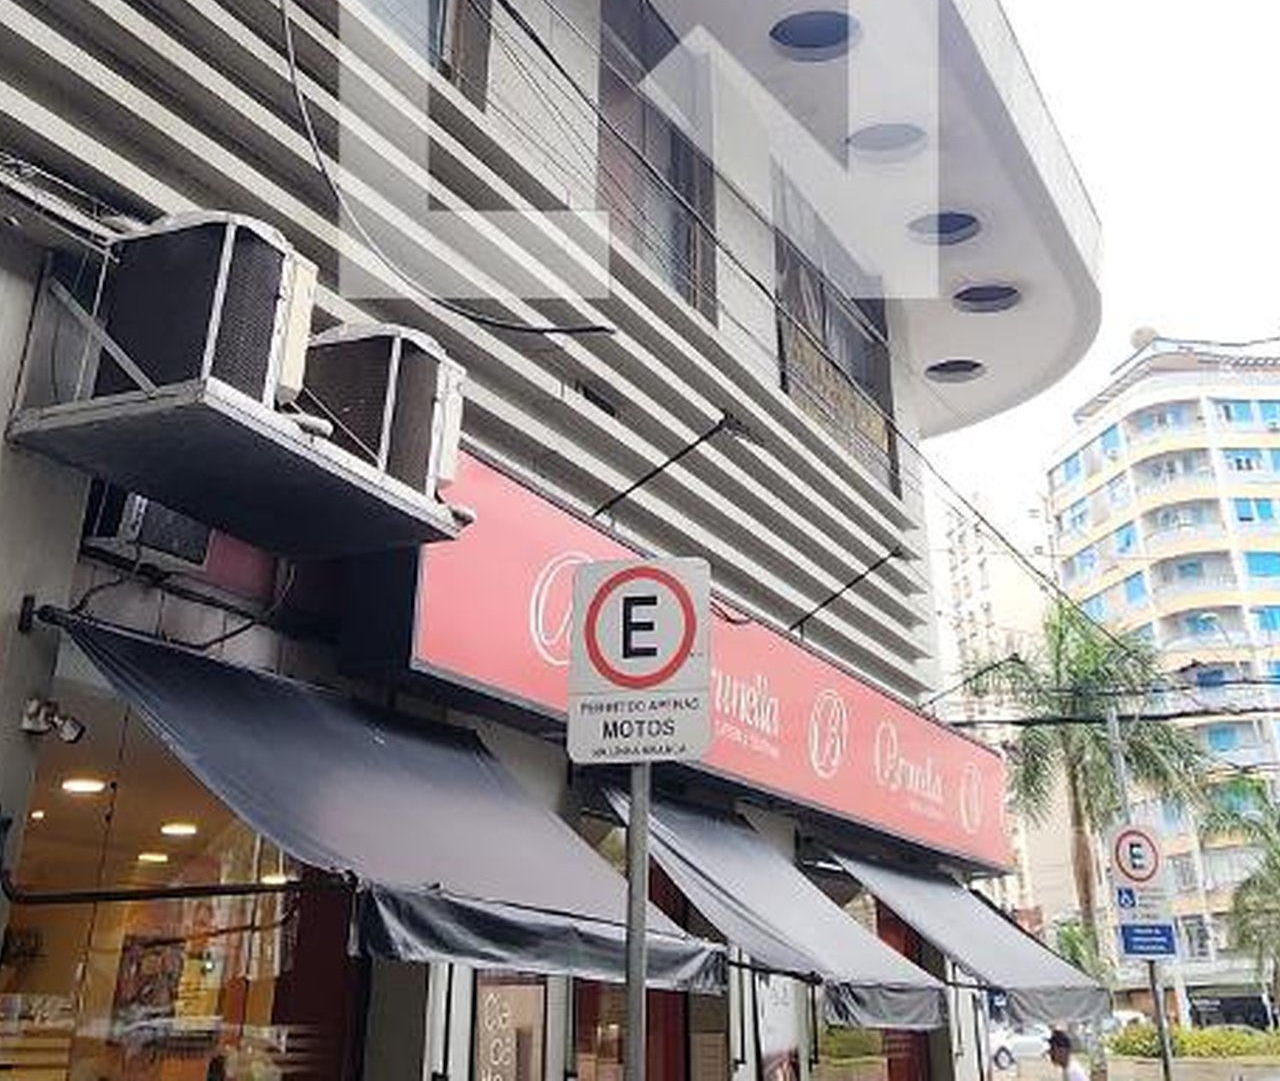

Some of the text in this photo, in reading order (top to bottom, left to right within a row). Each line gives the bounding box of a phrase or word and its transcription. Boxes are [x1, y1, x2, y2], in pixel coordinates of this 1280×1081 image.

[622, 595, 658, 659] E
[603, 718, 675, 740] MOTOS
[1130, 843, 1145, 869] E
